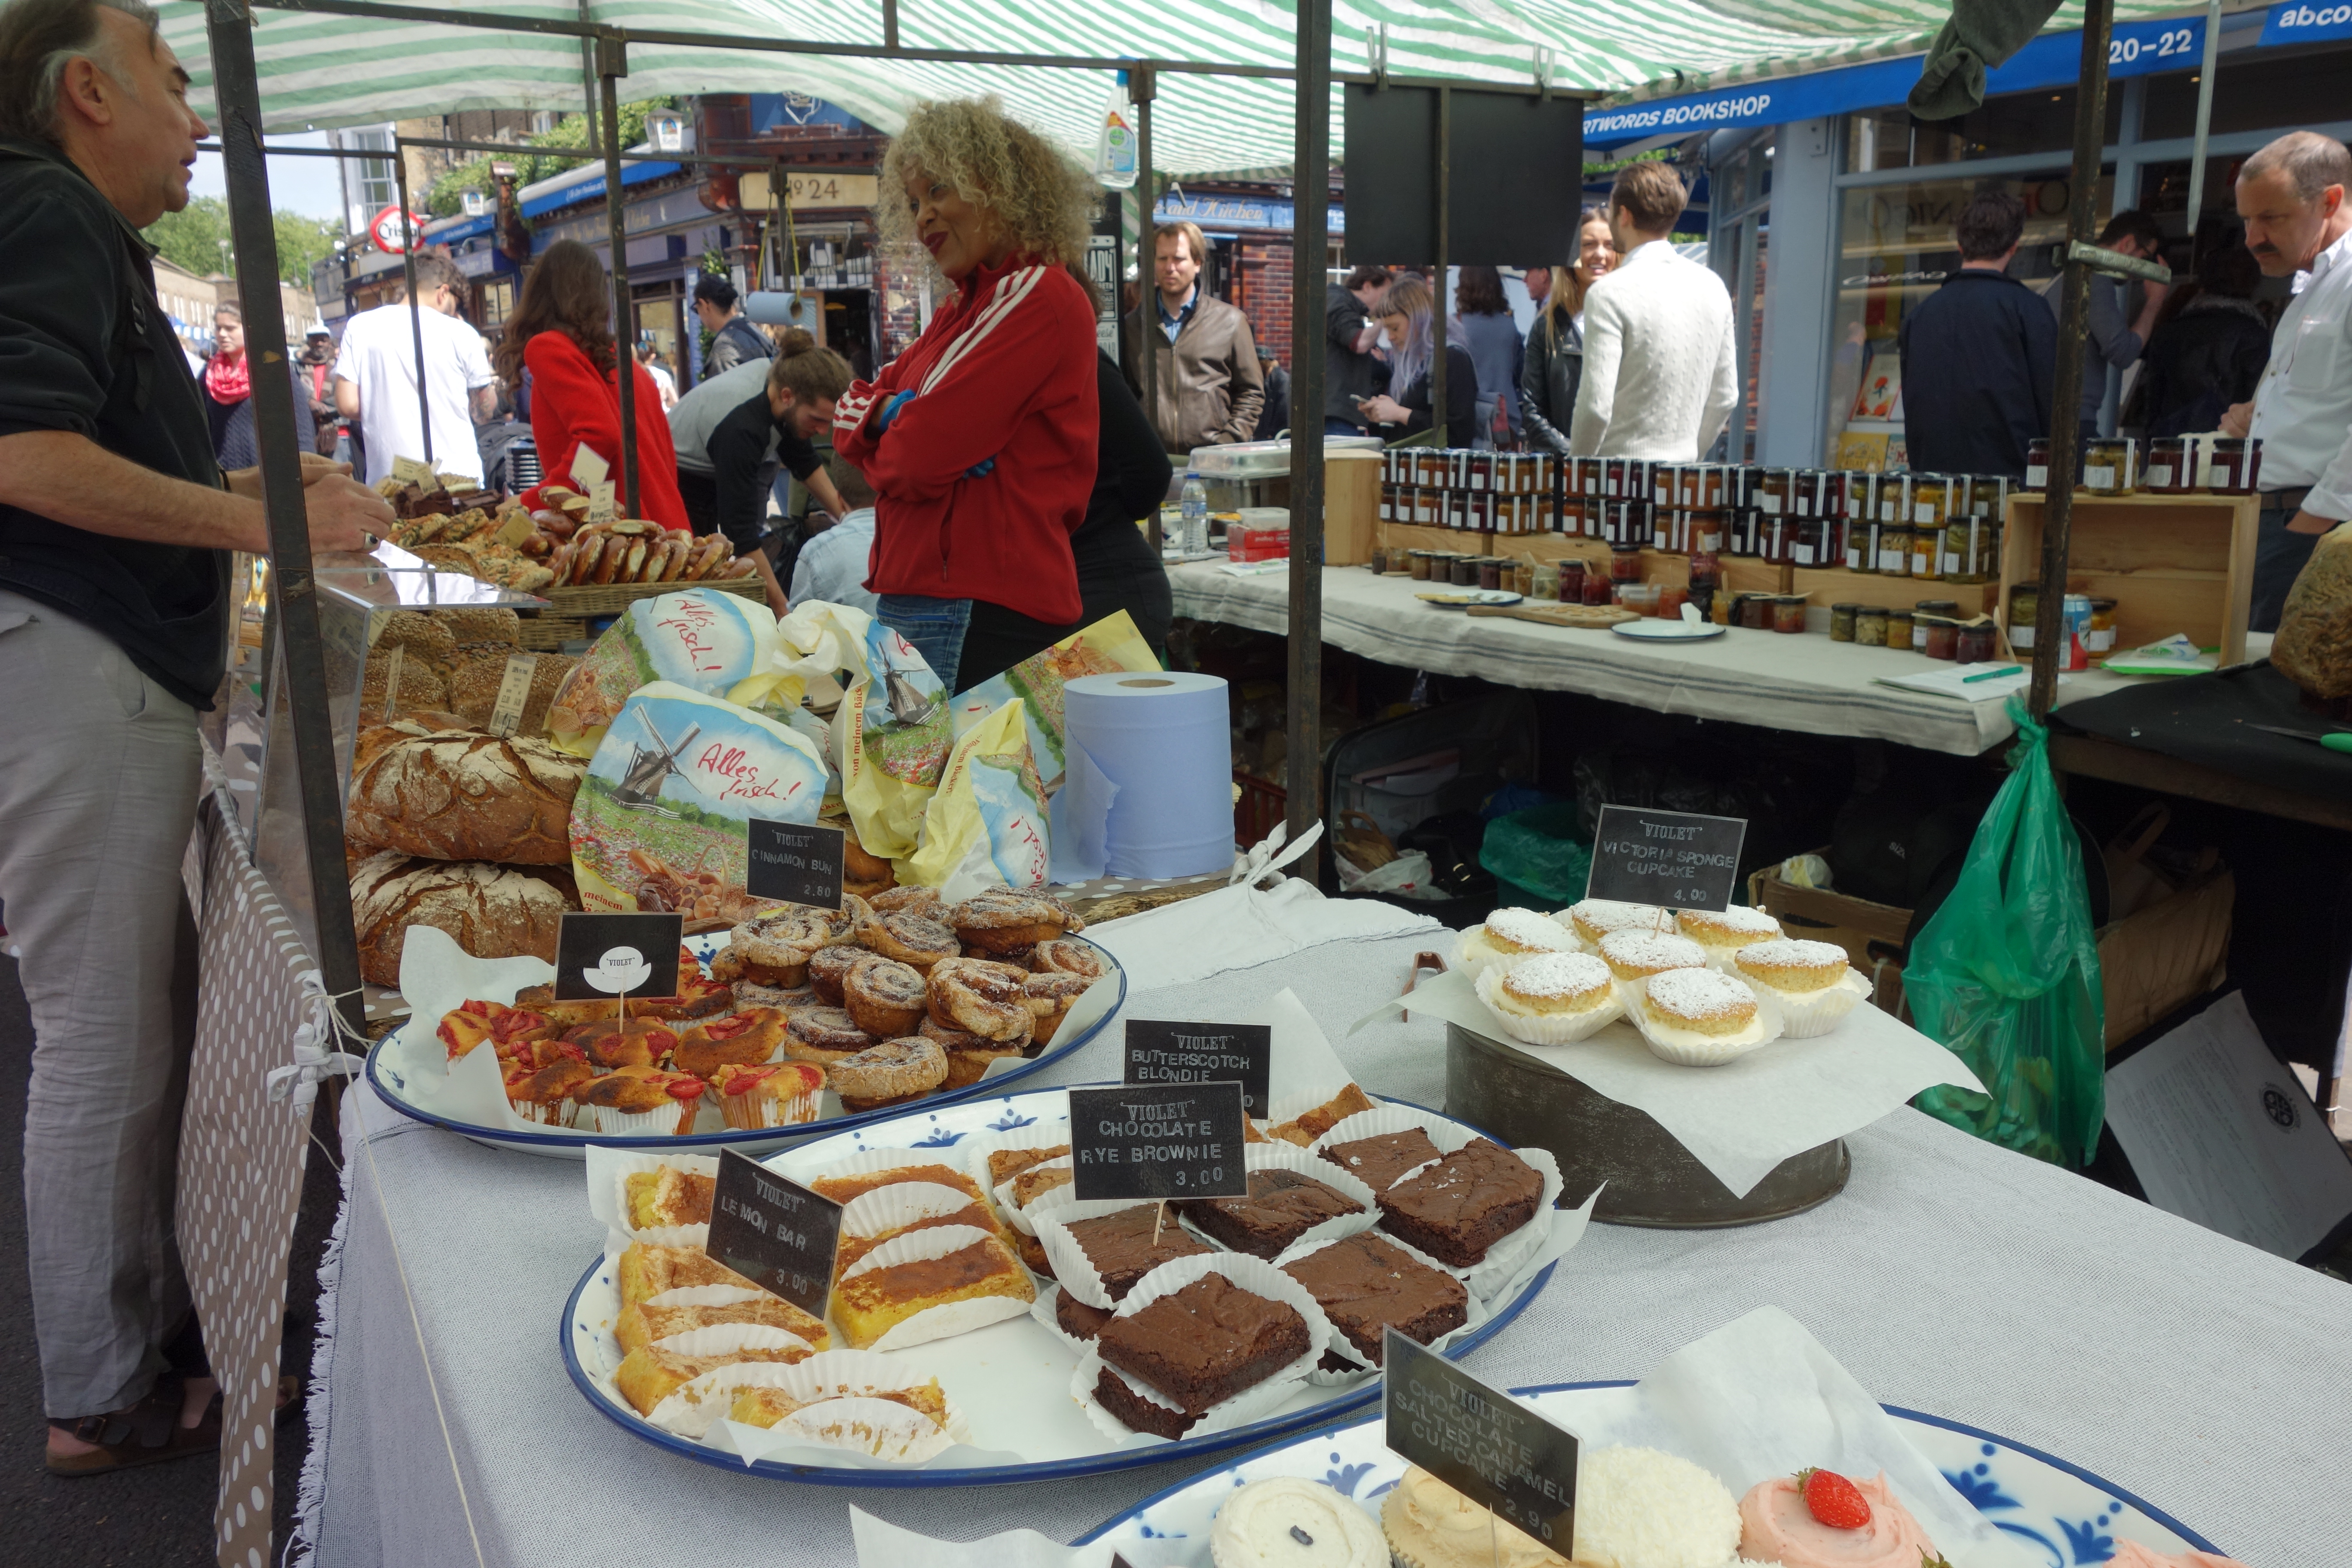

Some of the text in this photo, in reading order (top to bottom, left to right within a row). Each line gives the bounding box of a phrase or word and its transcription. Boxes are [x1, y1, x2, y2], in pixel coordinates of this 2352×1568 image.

[2279, 4, 2352, 28] abco
[1583, 94, 1771, 135] RTWORDS BOOKSHOP
[808, 178, 840, 199] 24
[1198, 197, 1263, 220] Kitchen
[674, 600, 718, 628] Alles
[657, 618, 722, 672] frisch!
[853, 713, 862, 755] meinem
[697, 743, 759, 783] Alles
[719, 778, 802, 801] frisch!
[820, 802, 844, 812] cker!
[773, 830, 813, 848] VIOLET
[1642, 821, 1700, 840] VIOLET
[751, 849, 832, 875] CINNAMON BUN
[1603, 841, 1735, 868] VICTORIA SPONGE
[1626, 861, 1696, 878] CUPCAKE
[583, 891, 623, 911] meinem
[803, 884, 831, 898] 2.80
[1673, 888, 1707, 902] 4.00
[607, 958, 634, 966] VIOLET
[1172, 1033, 1233, 1050] VIOLET
[1132, 1049, 1250, 1069] BUTTERSCOTCH
[1138, 1066, 1211, 1082] BLONDIE
[1122, 1101, 1193, 1121] VIOLET
[1099, 1121, 1212, 1138] CHOCOLATE
[1081, 1143, 1222, 1164] RYE BROWNIE
[1175, 1167, 1223, 1186] 3.00
[754, 1174, 804, 1213] VIOLET
[721, 1195, 806, 1251] LEMON BAR
[776, 1268, 807, 1295] 3.00
[1443, 1375, 1522, 1433] VIOLET
[1409, 1379, 1533, 1466] CHOCOLATE
[1395, 1391, 1571, 1508] SALTED CARAMEL
[1411, 1421, 1507, 1491] CUPCAKE
[1505, 1498, 1553, 1540] 2.90
